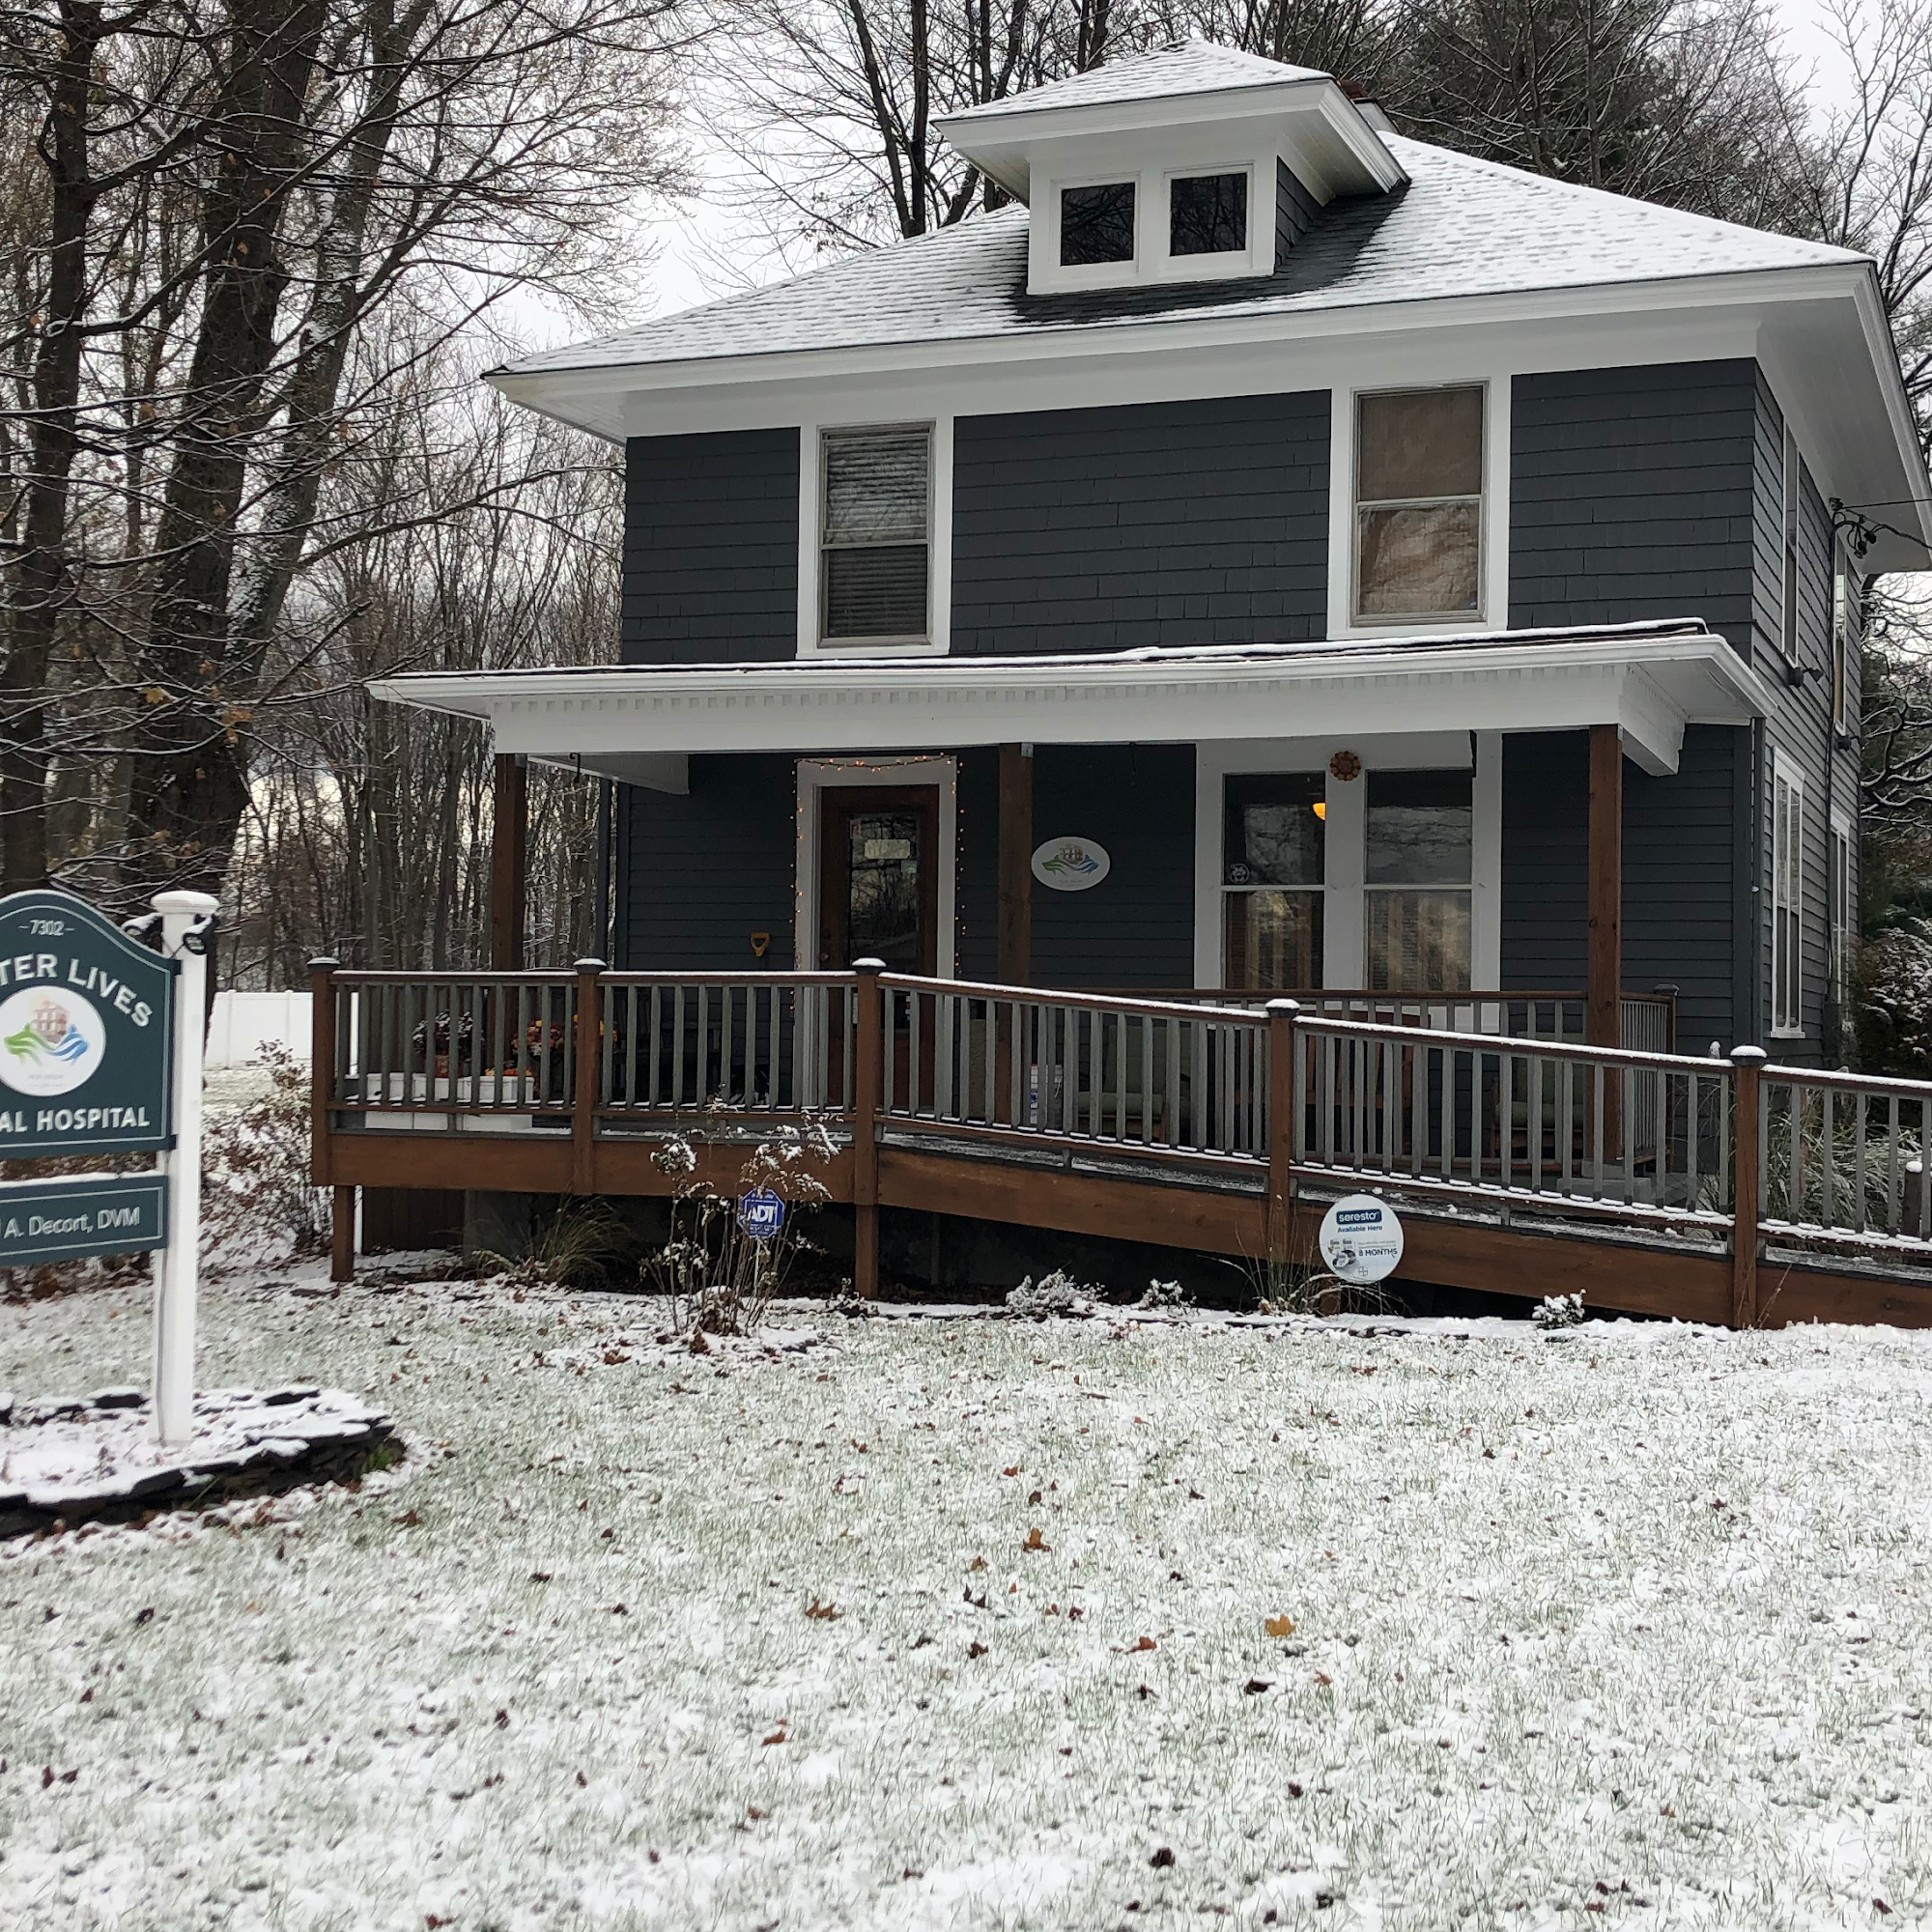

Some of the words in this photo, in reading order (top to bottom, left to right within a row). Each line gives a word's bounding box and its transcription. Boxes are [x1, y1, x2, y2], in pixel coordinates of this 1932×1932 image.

[67, 957, 154, 1028] LIVES
[37, 1106, 151, 1132] HOSPITAL
[3, 1217, 25, 1239] A.
[28, 1213, 94, 1237] Decort,
[97, 1206, 141, 1231] DVM
[747, 1205, 774, 1223] ADT
[1339, 1211, 1377, 1222] seresto
